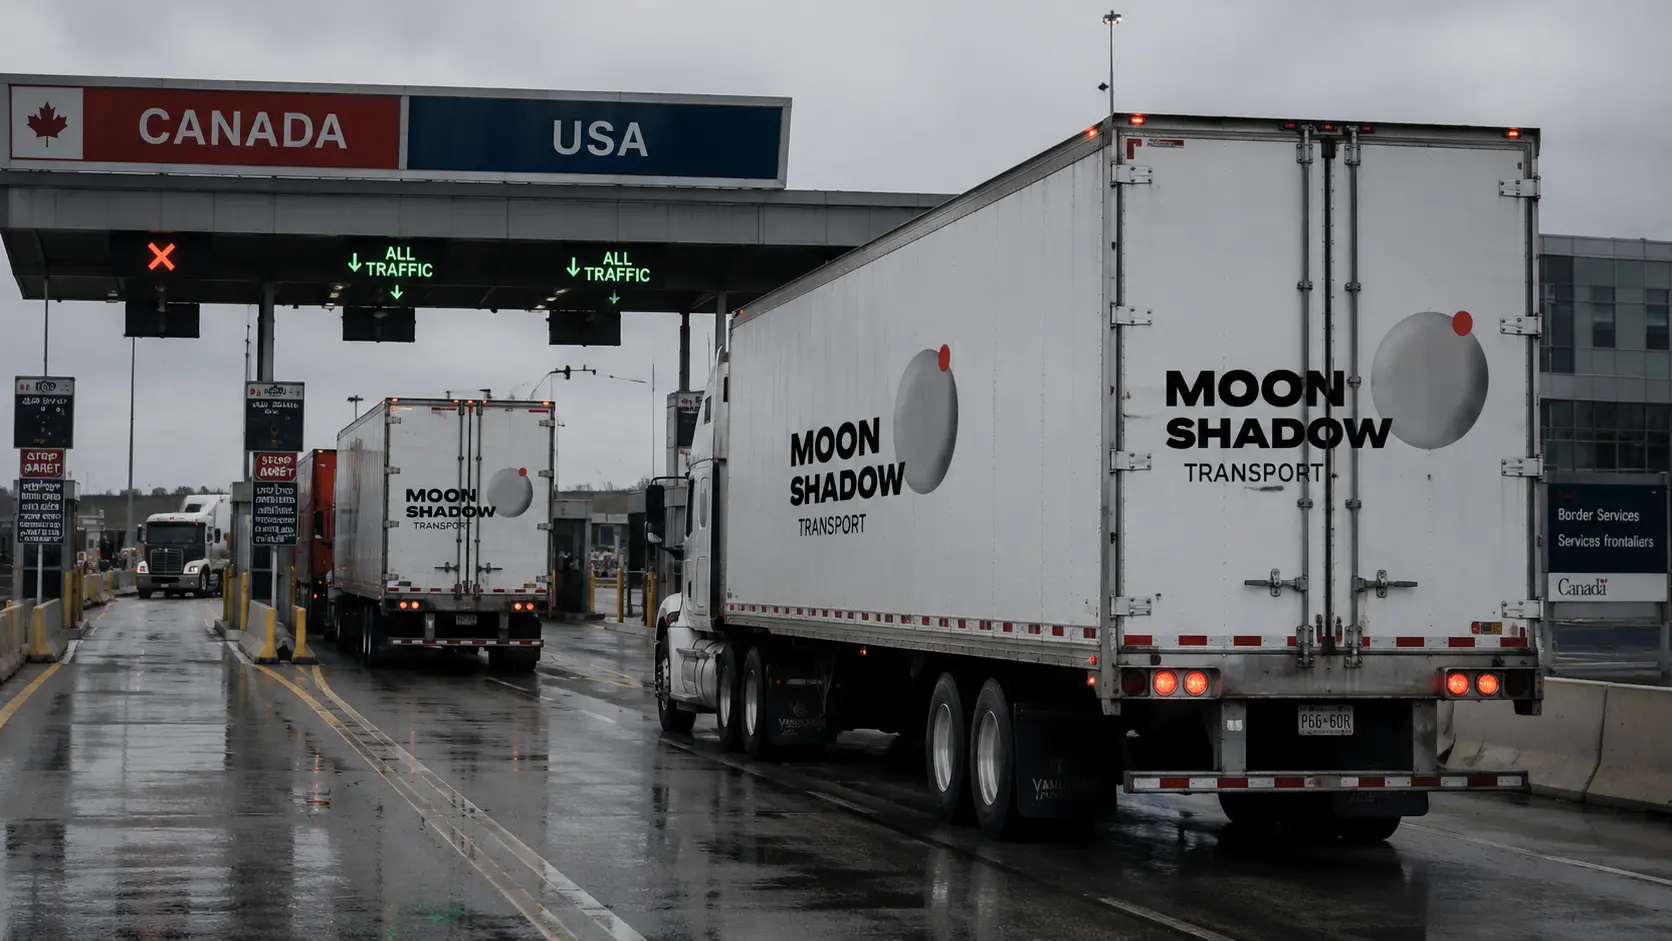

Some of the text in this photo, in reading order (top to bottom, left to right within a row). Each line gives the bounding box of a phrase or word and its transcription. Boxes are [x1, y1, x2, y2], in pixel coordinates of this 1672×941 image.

[138, 107, 348, 150] CANADA
[552, 119, 649, 158] USA
[385, 246, 416, 261] ALL
[602, 251, 632, 266] ALL
[365, 262, 433, 278] TRAFFIC
[584, 266, 651, 282] TRAFFIC
[1165, 369, 1345, 408] MOON
[790, 416, 880, 467] MOON
[1165, 416, 1394, 450] SHADOW
[1183, 462, 1325, 483] TRANSPORT
[790, 461, 906, 507] SHADOW
[405, 488, 477, 503] MOON
[405, 505, 497, 518] SHADOW
[1558, 507, 1640, 522] Border Services
[413, 521, 472, 530] TRANSPORT
[798, 513, 867, 537] TRANSPORT
[1558, 533, 1654, 548] Services frontaliers
[1558, 577, 1608, 596] Canada
